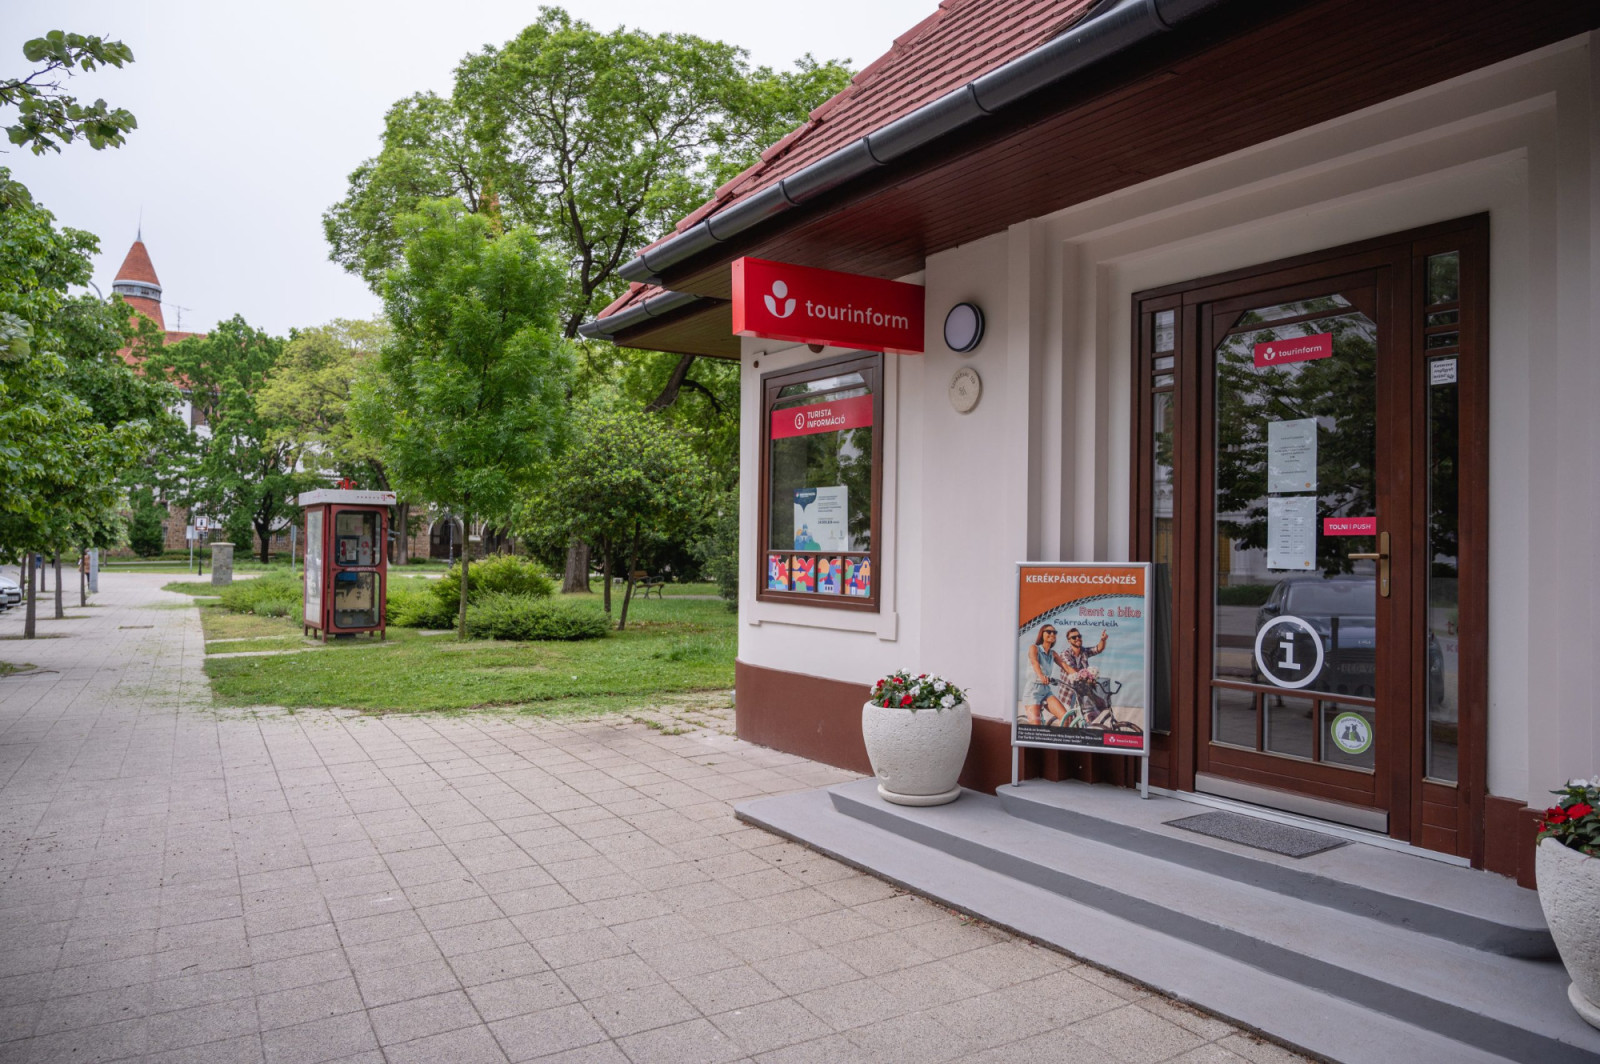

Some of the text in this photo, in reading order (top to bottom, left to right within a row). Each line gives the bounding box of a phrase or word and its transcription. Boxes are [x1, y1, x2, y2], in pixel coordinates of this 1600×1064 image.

[805, 300, 909, 330] tourinform
[1278, 344, 1322, 357] tourinform
[807, 409, 832, 419] TURISTA
[807, 414, 845, 428] INFORMÁCIÓ
[1026, 573, 1137, 585] KERÉKPÁRKÖLCSÖNZÉS
[1079, 606, 1141, 618] Rent a bike
[1053, 618, 1119, 627] Fahrradverleih
